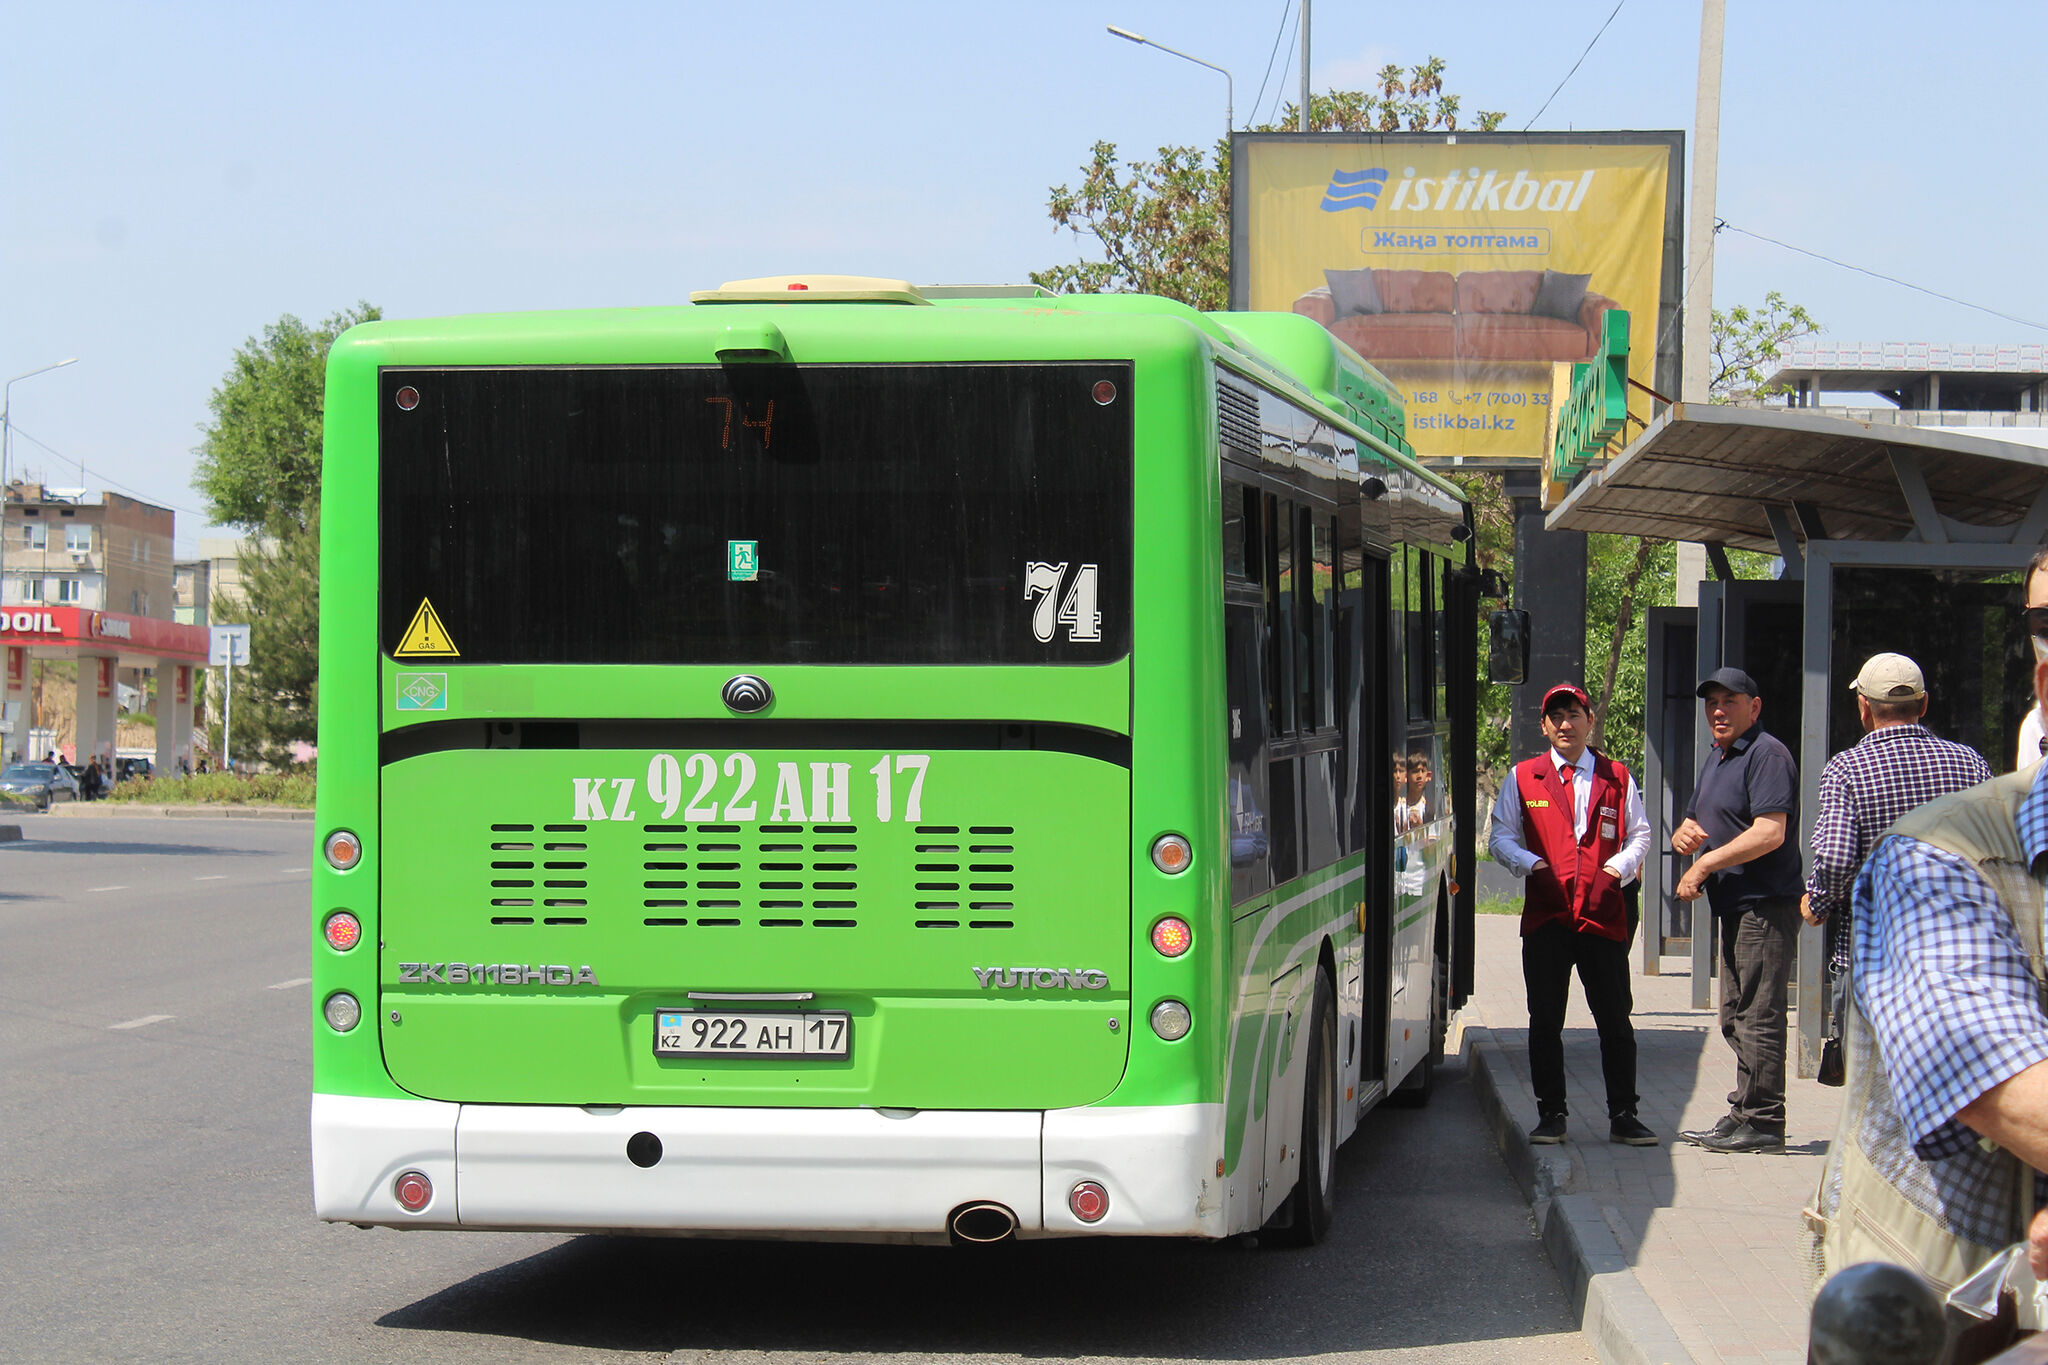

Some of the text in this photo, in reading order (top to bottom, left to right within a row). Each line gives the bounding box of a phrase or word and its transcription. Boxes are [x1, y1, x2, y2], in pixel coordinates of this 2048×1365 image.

[1389, 166, 1596, 212] istikbal
[1373, 231, 1539, 250] Жаңа топтама
[1412, 391, 1439, 404] 168
[1464, 392, 1482, 404] +7
[1487, 391, 1527, 407] (700)
[705, 397, 774, 449] 74
[1413, 413, 1516, 430] istikbal.kz
[1023, 561, 1102, 643] 74
[418, 642, 436, 650] GAS
[408, 685, 436, 698] CNG
[572, 752, 931, 823] KZ 922 AH 17
[398, 962, 600, 986] ZK6118HGA
[971, 966, 1108, 990] YUTONG
[660, 1018, 845, 1050] KZ 922 AH 17
